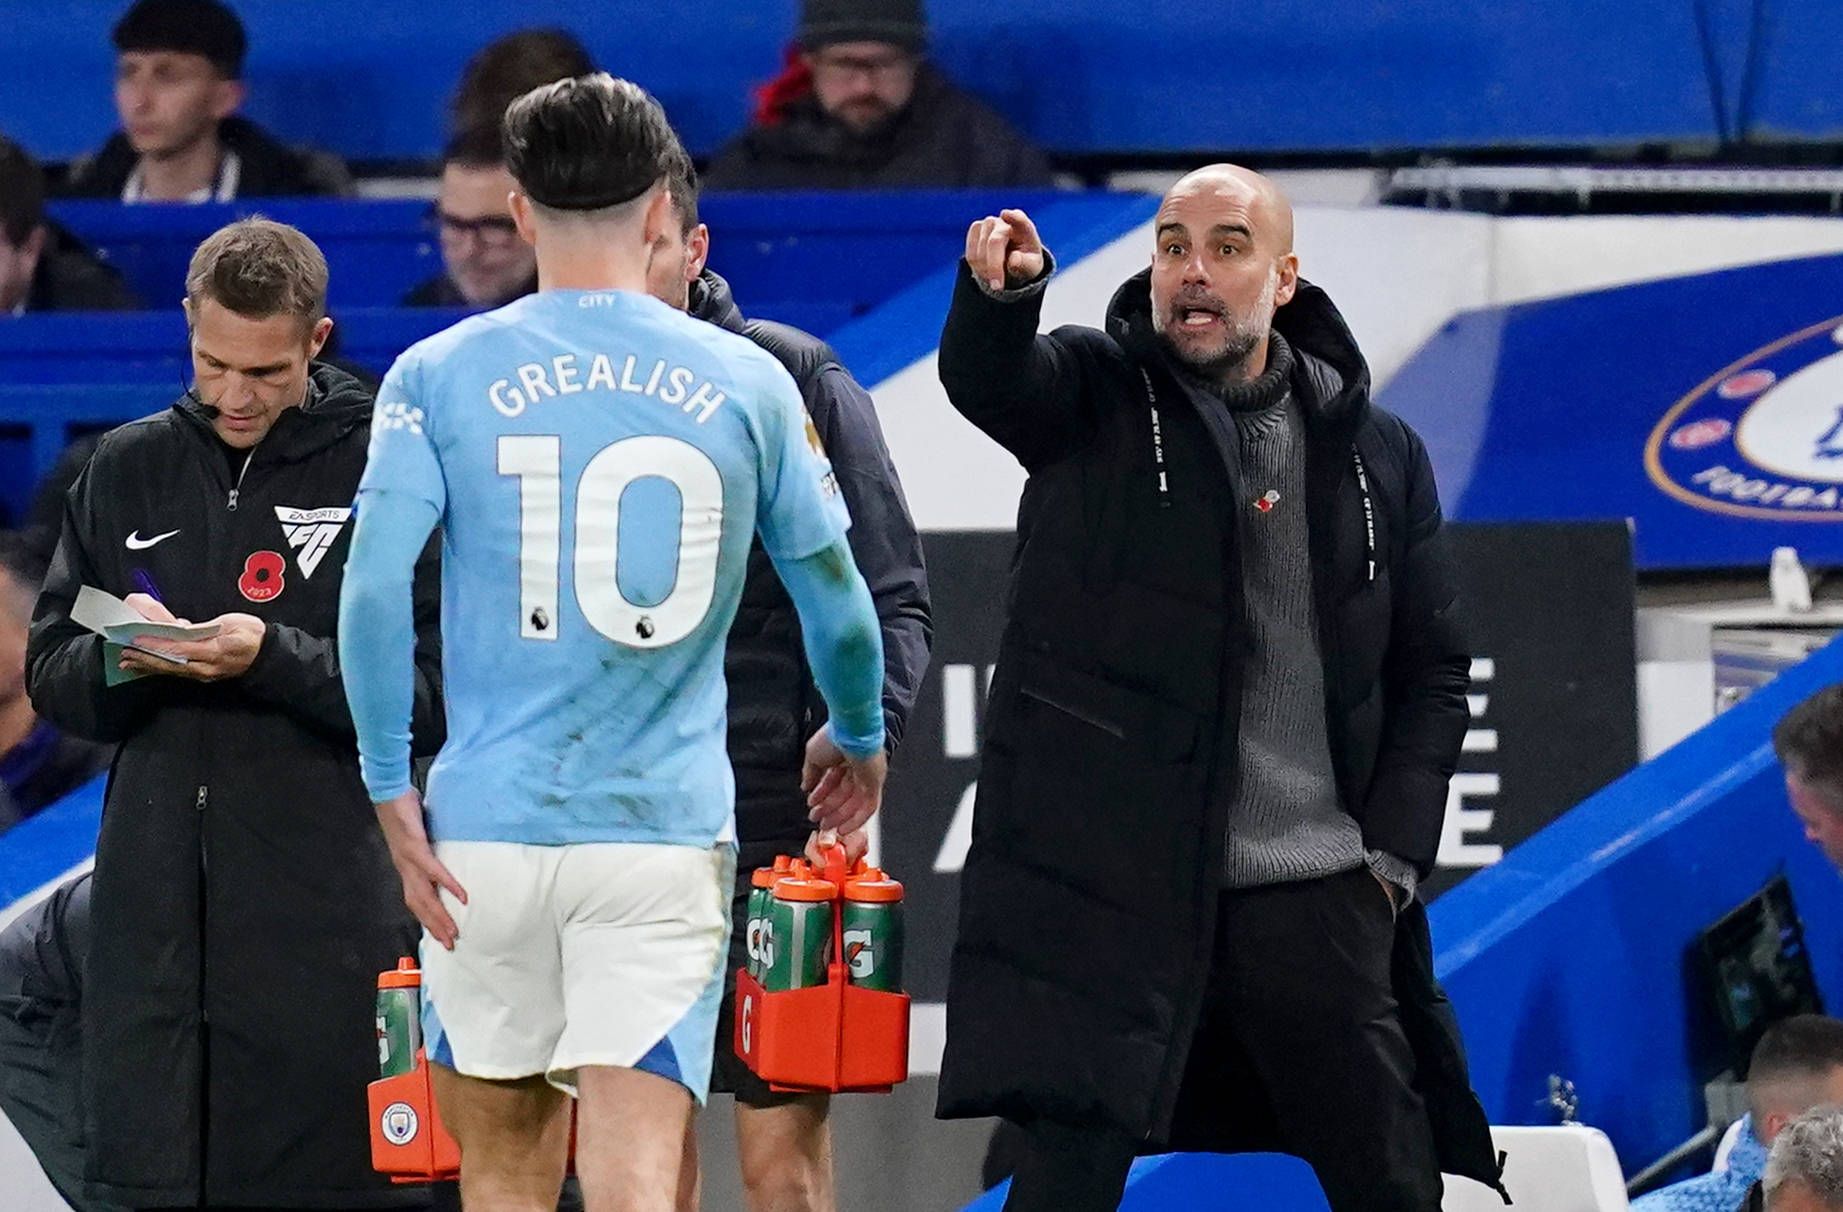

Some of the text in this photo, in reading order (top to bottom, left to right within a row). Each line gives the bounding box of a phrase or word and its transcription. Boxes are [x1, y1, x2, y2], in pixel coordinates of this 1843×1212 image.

[578, 294, 616, 308] CITY
[488, 353, 727, 423] GREALISH
[1691, 465, 1843, 508] FOOTBA
[306, 509, 340, 520] SPORTS
[497, 434, 725, 648] 10
[246, 586, 273, 598] 2023
[843, 929, 875, 978] G
